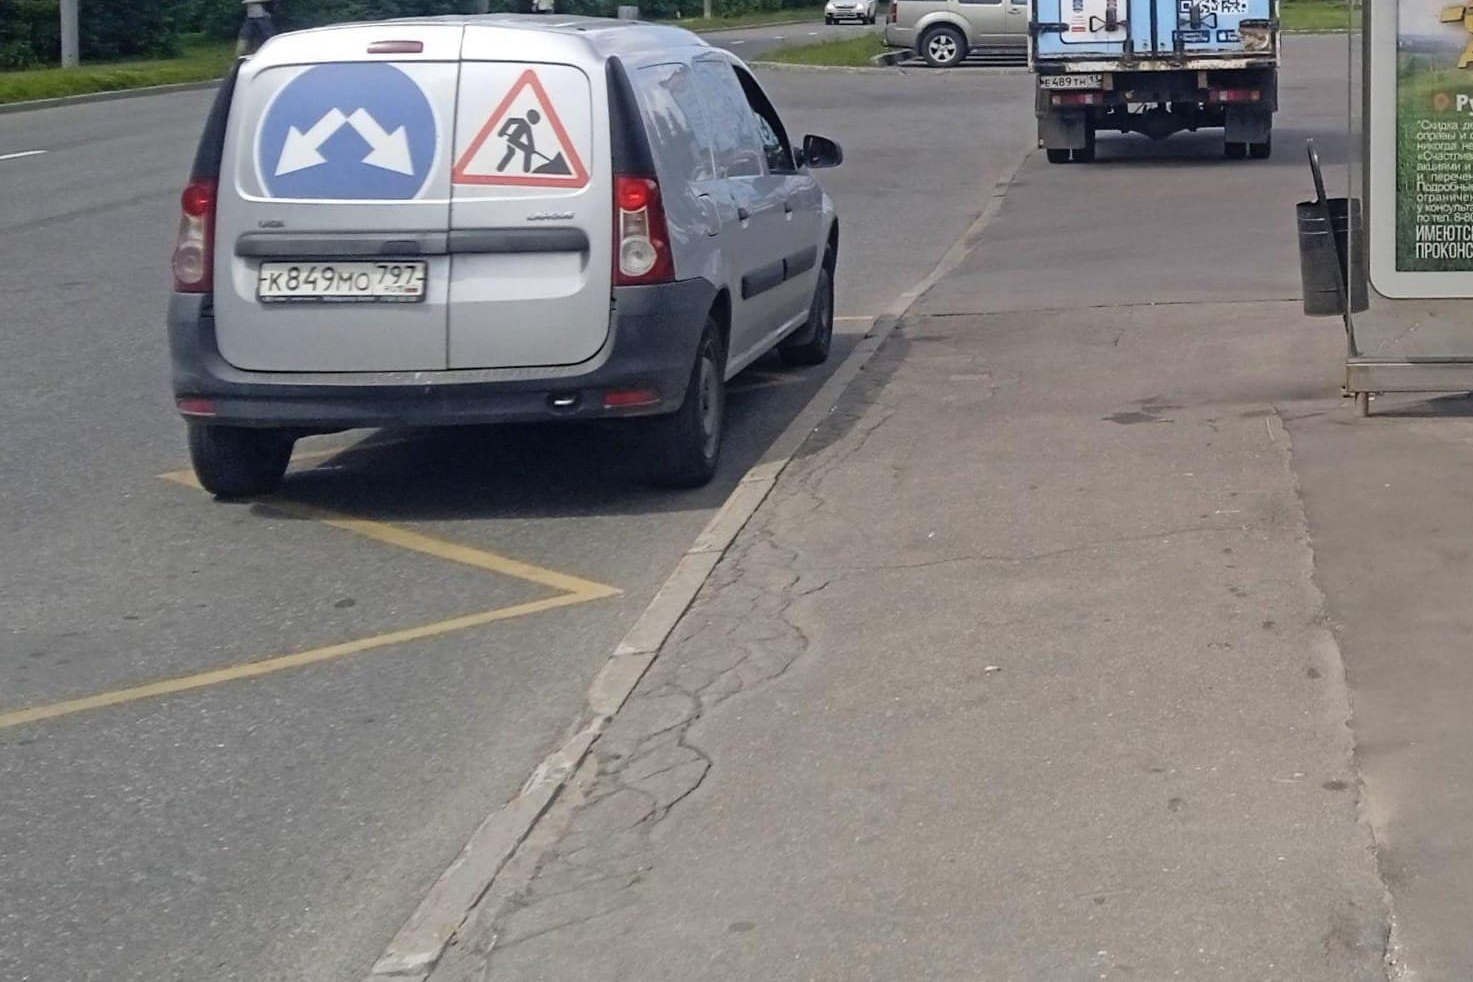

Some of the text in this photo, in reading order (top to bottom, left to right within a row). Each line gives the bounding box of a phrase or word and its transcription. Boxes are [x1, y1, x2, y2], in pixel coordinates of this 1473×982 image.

[1417, 214, 1430, 223] по
[268, 265, 417, 292] К849МО 797
